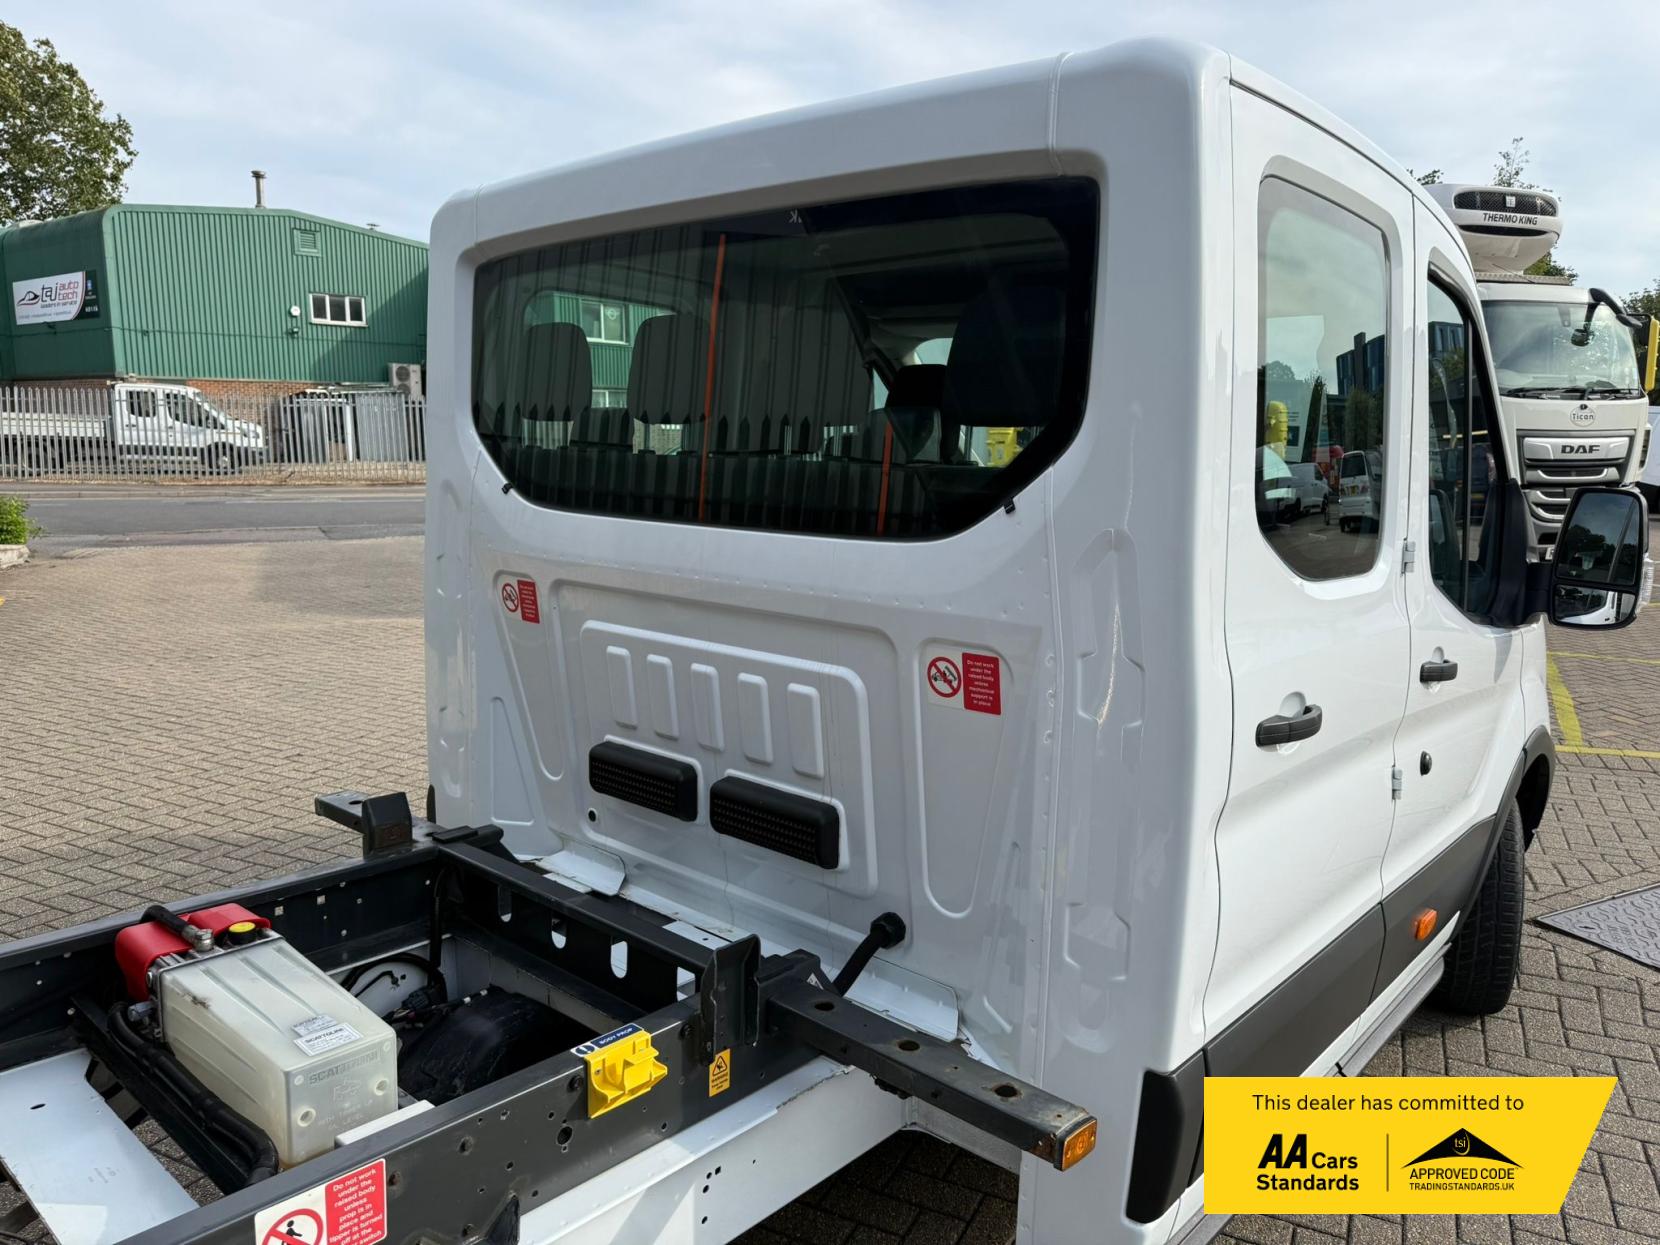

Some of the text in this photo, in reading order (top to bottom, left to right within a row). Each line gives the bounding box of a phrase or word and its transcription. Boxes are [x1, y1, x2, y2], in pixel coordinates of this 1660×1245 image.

[1483, 212, 1538, 225] THERMO KING
[59, 280, 78, 290] auto
[41, 282, 58, 302] taj
[58, 291, 78, 300] tech
[1561, 445, 1600, 454] DAF
[333, 1169, 376, 1192] Do not work
[334, 1186, 375, 1208] raised body
[338, 1185, 359, 1198] under
[344, 1198, 368, 1211] unless
[339, 1211, 356, 1223] prop
[339, 1210, 373, 1231] place and
[330, 1230, 350, 1243] tipper
[360, 1214, 382, 1228] turned
[360, 1230, 382, 1244] switch
